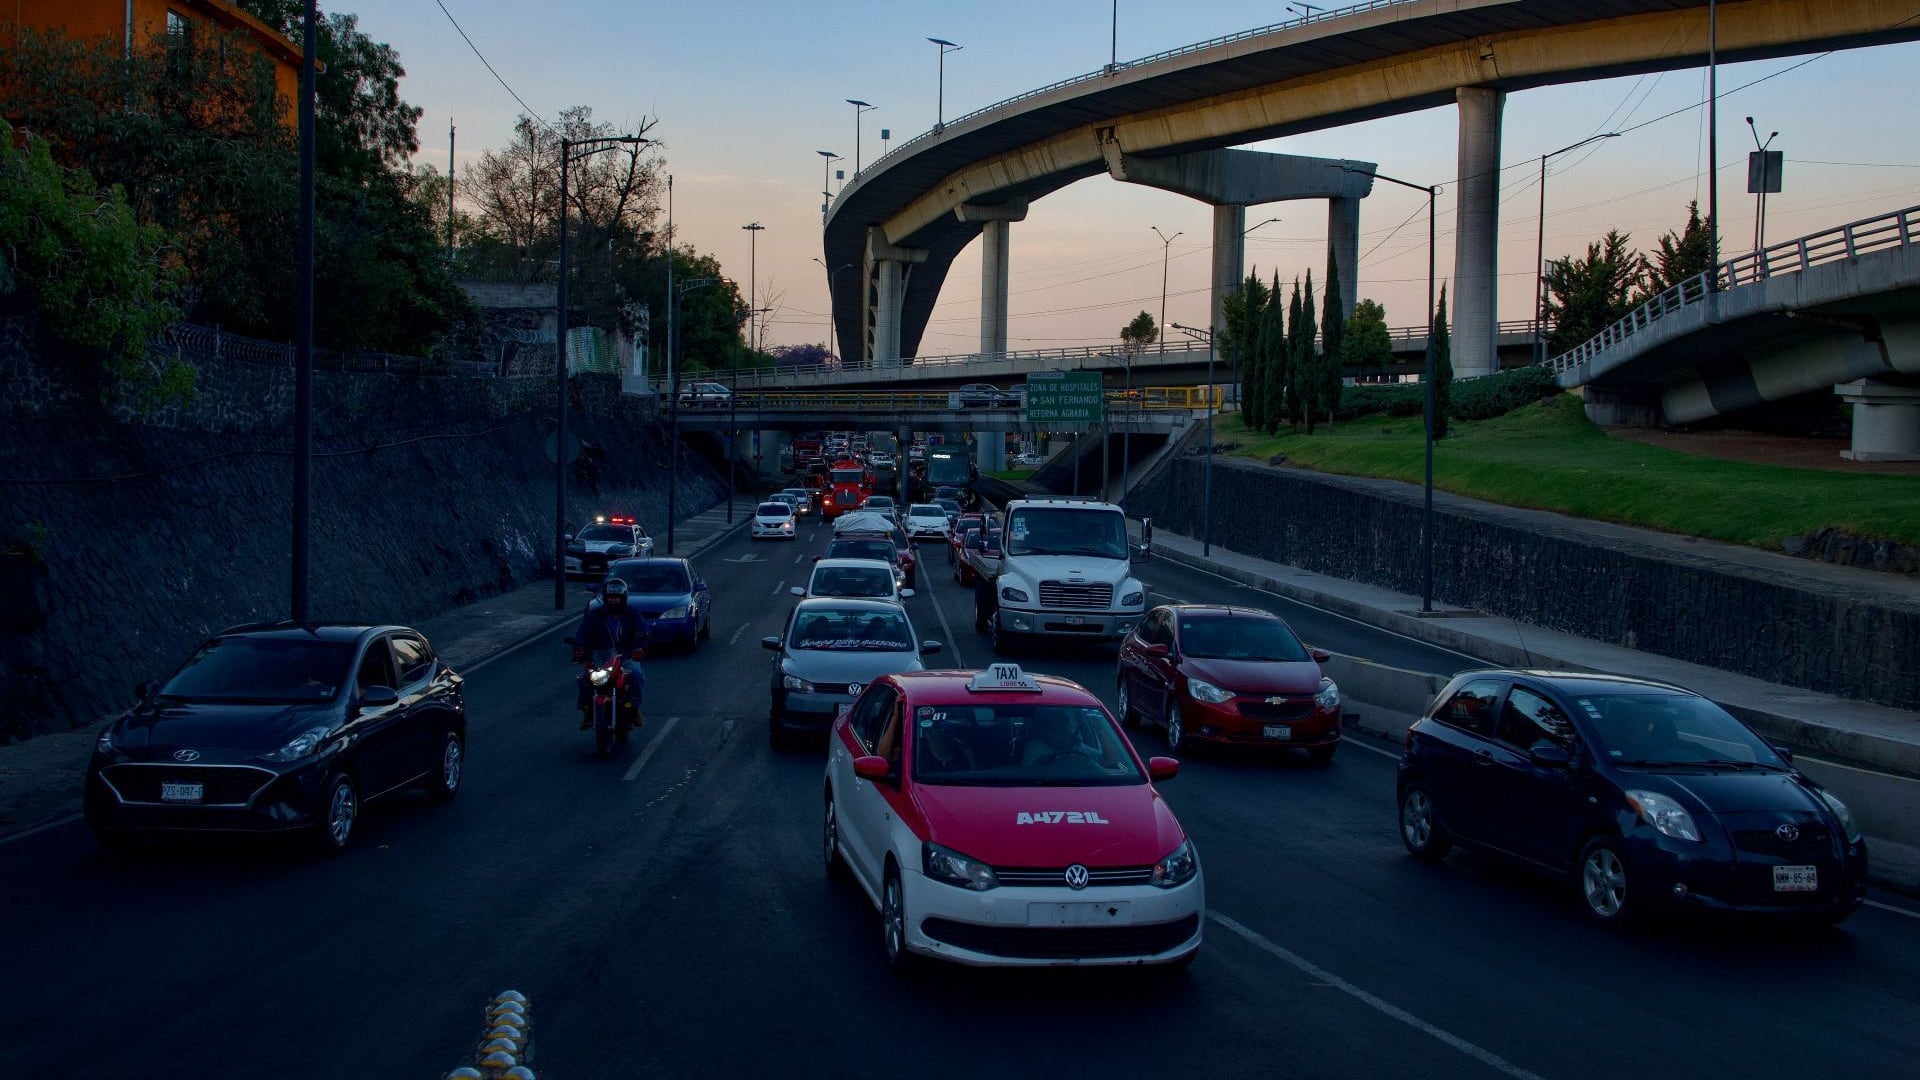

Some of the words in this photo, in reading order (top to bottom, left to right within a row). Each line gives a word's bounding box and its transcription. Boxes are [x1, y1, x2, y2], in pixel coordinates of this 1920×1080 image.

[1029, 383, 1047, 392] ZONA
[1049, 383, 1058, 392] DE
[1060, 383, 1099, 392] HOSPITALES
[1040, 395, 1056, 405] SAN
[1059, 395, 1099, 404] FERNANDO
[1029, 409, 1058, 418] REFORMA
[1061, 408, 1090, 418] AGRARIA
[995, 666, 1018, 680] TAXI
